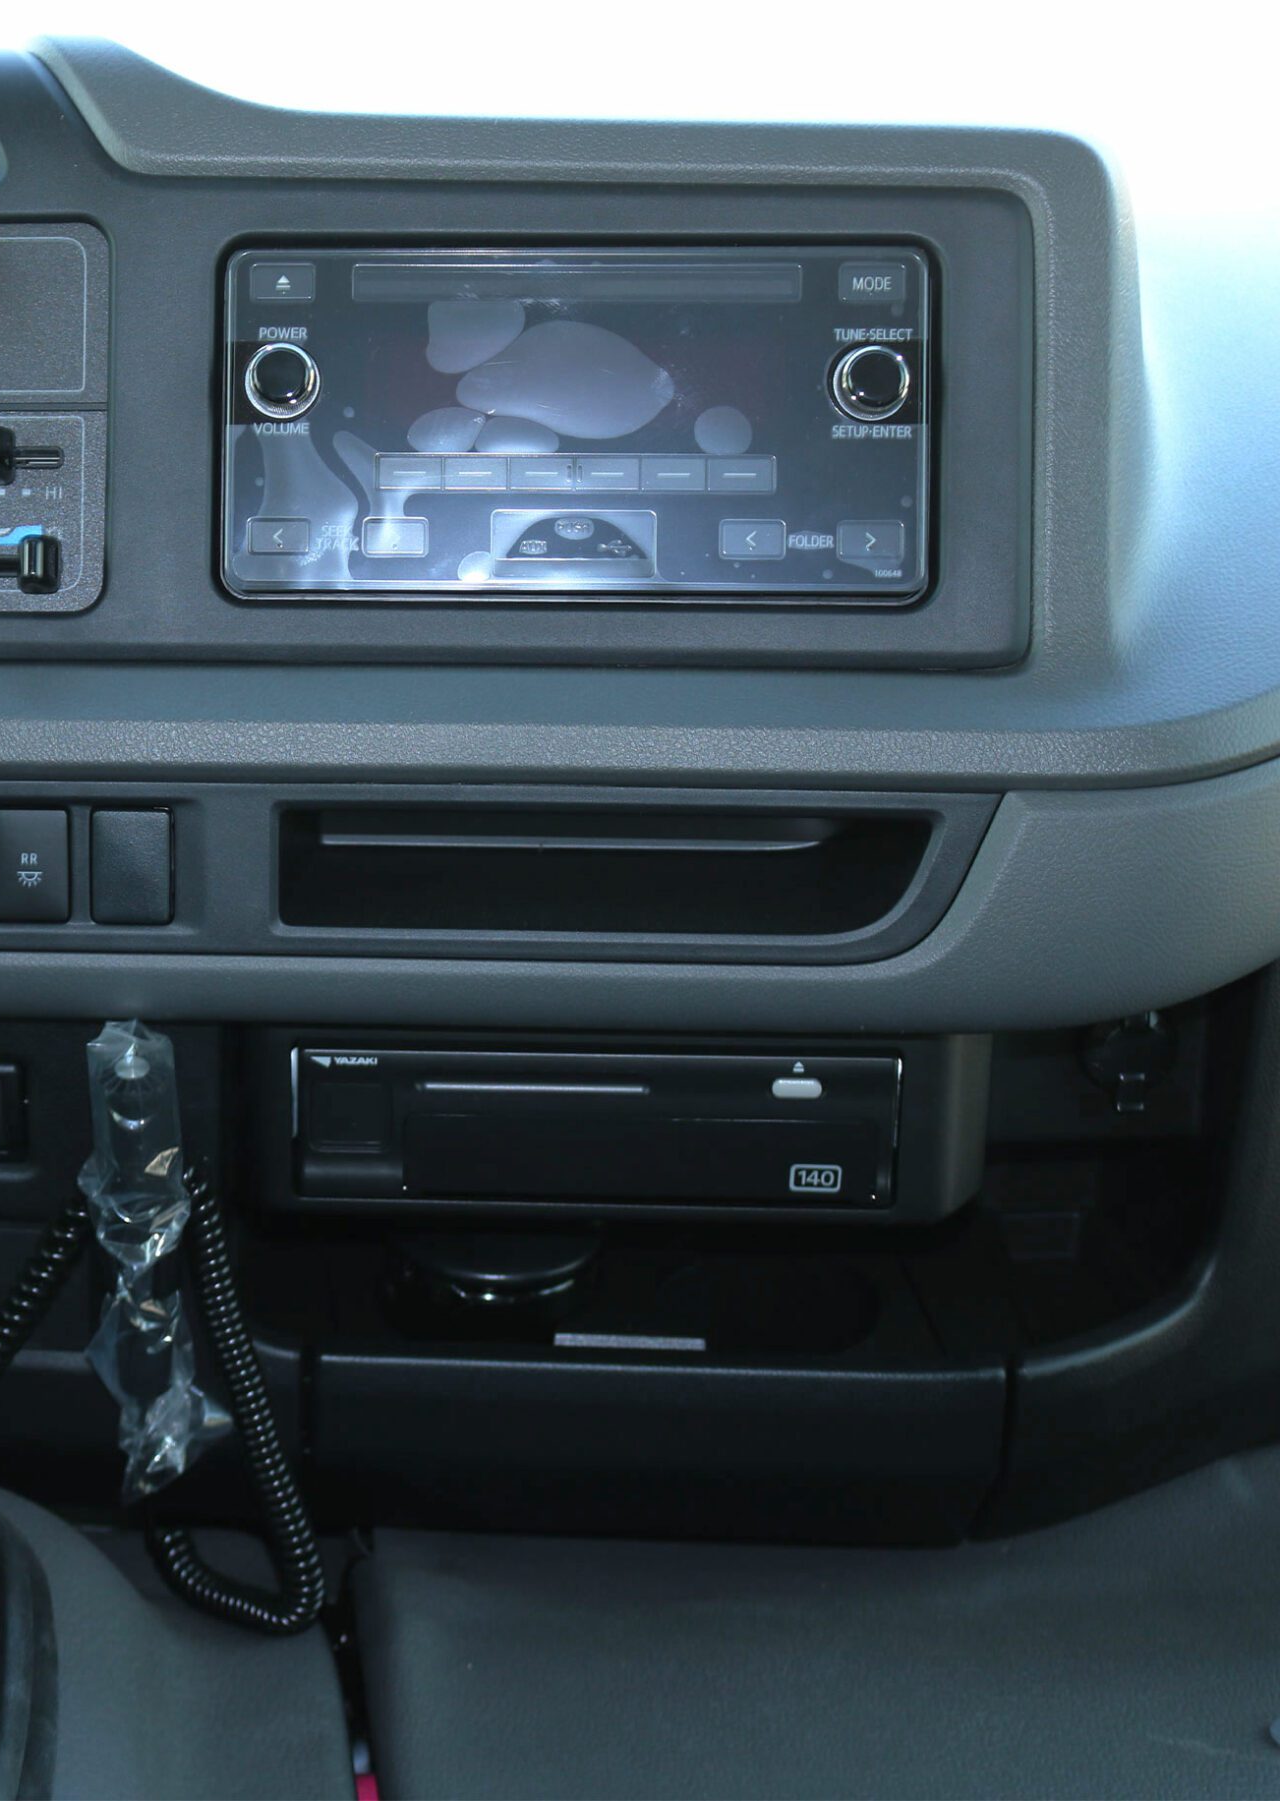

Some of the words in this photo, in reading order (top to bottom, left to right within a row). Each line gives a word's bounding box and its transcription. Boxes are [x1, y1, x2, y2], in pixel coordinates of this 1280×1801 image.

[852, 276, 892, 291] MODE
[259, 326, 308, 340] POWER
[253, 422, 310, 435] VOLUME
[45, 486, 63, 500] HI
[788, 534, 834, 548] FOLDER
[20, 852, 39, 865] RR
[333, 1056, 378, 1066] YAZAKI
[798, 1169, 835, 1187] 140
